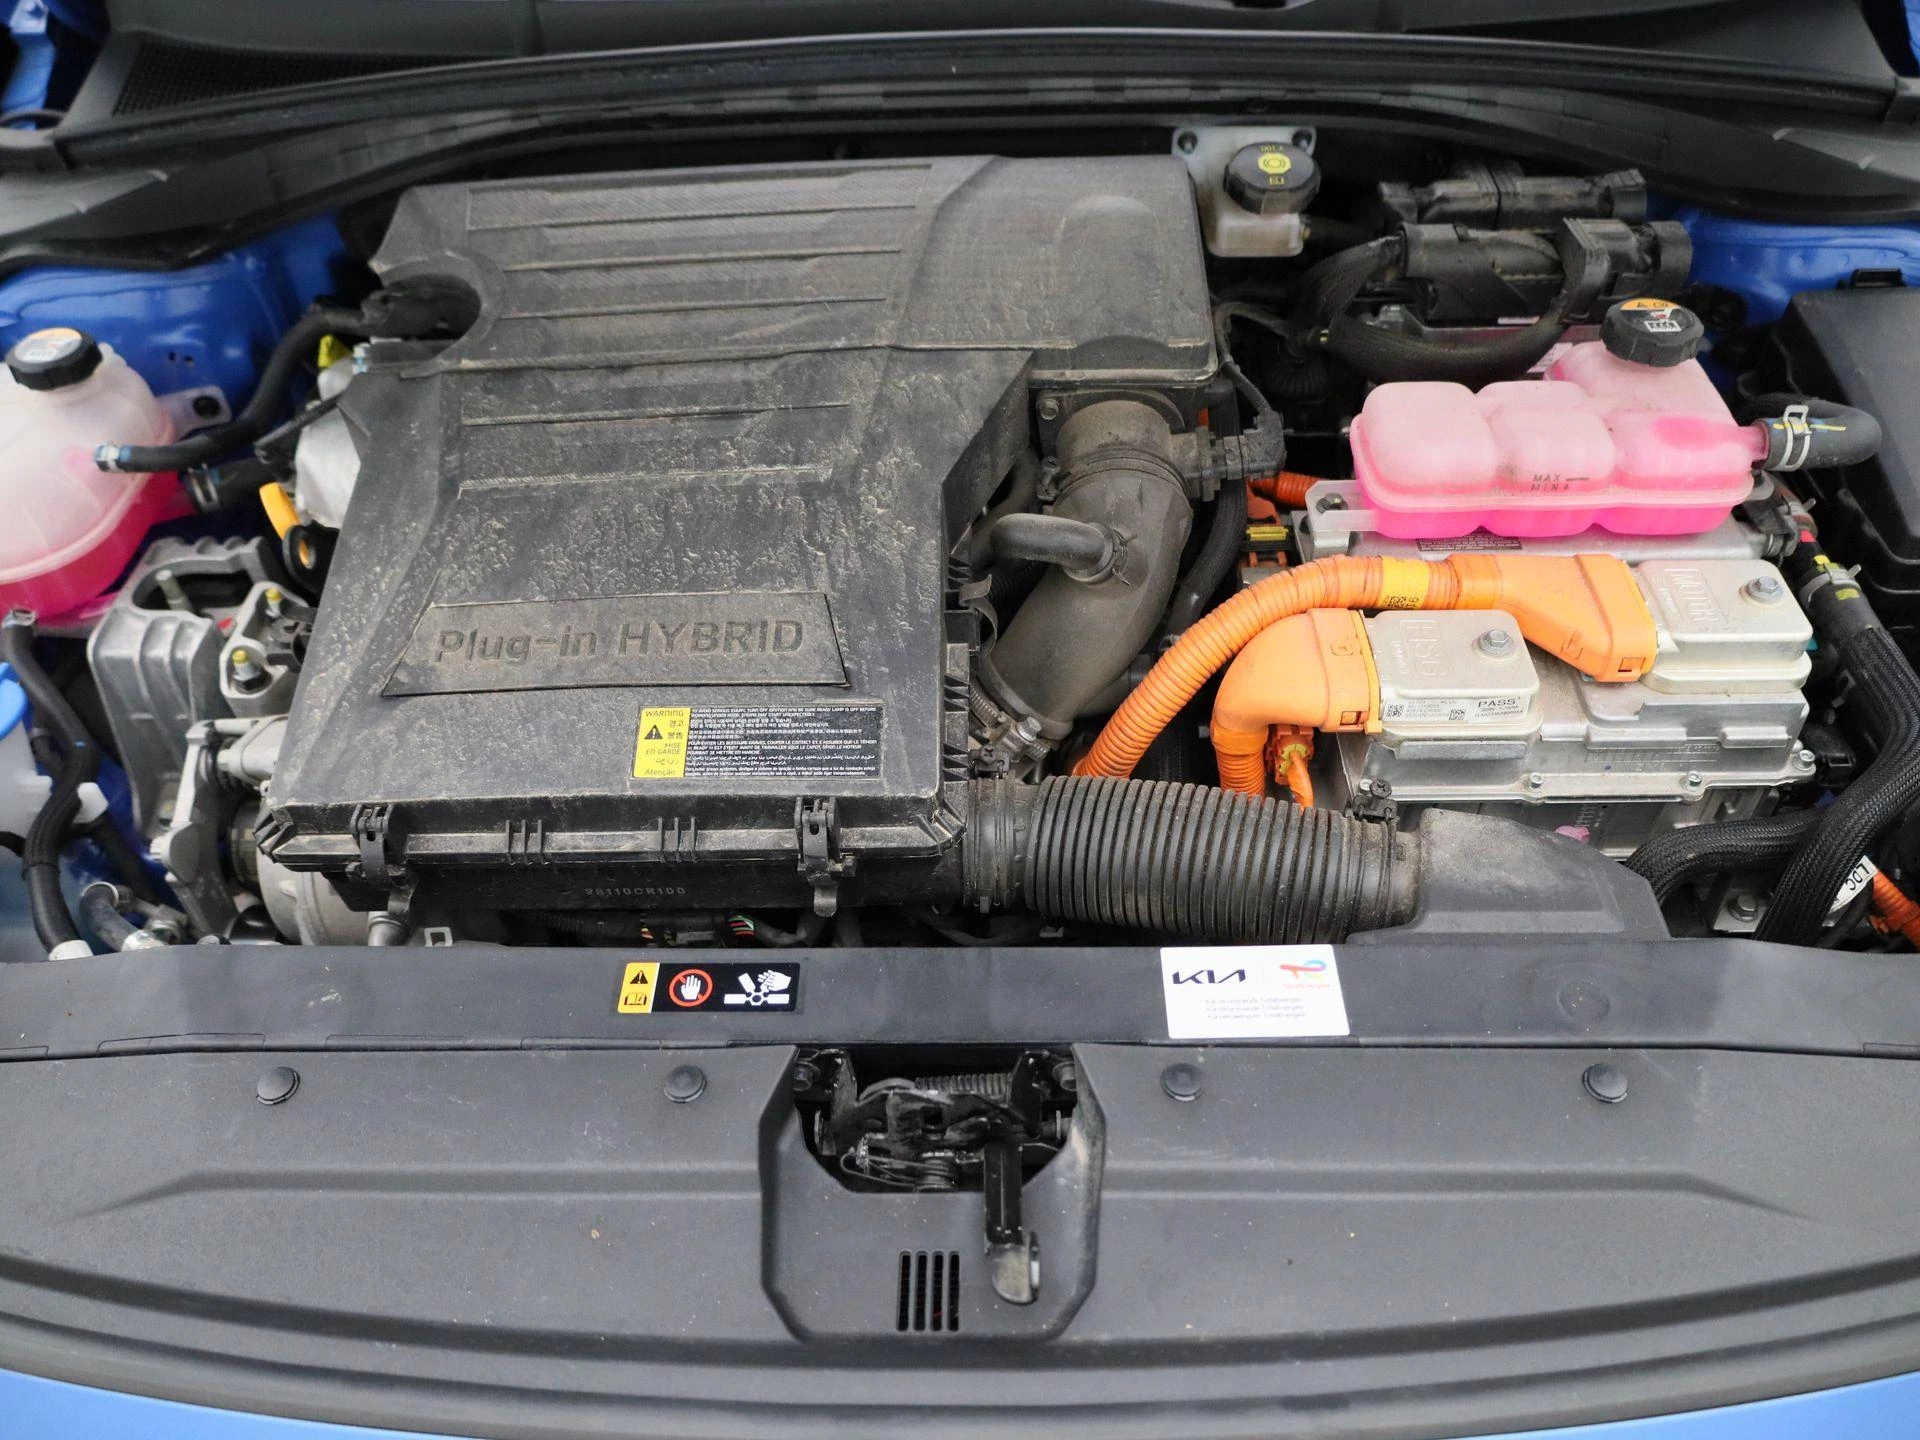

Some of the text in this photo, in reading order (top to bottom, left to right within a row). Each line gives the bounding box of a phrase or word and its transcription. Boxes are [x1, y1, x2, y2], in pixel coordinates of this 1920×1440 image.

[1533, 474, 1560, 482] MAX
[1530, 483, 1559, 491] MIN
[1671, 573, 1720, 622] MOTOR
[433, 620, 804, 665] Plug-in HYBRID
[1478, 699, 1516, 708] PASS
[645, 709, 684, 717] WARNING
[645, 768, 675, 776] Atenção
[1845, 862, 1870, 891] LDC
[1172, 969, 1246, 984] KIA
